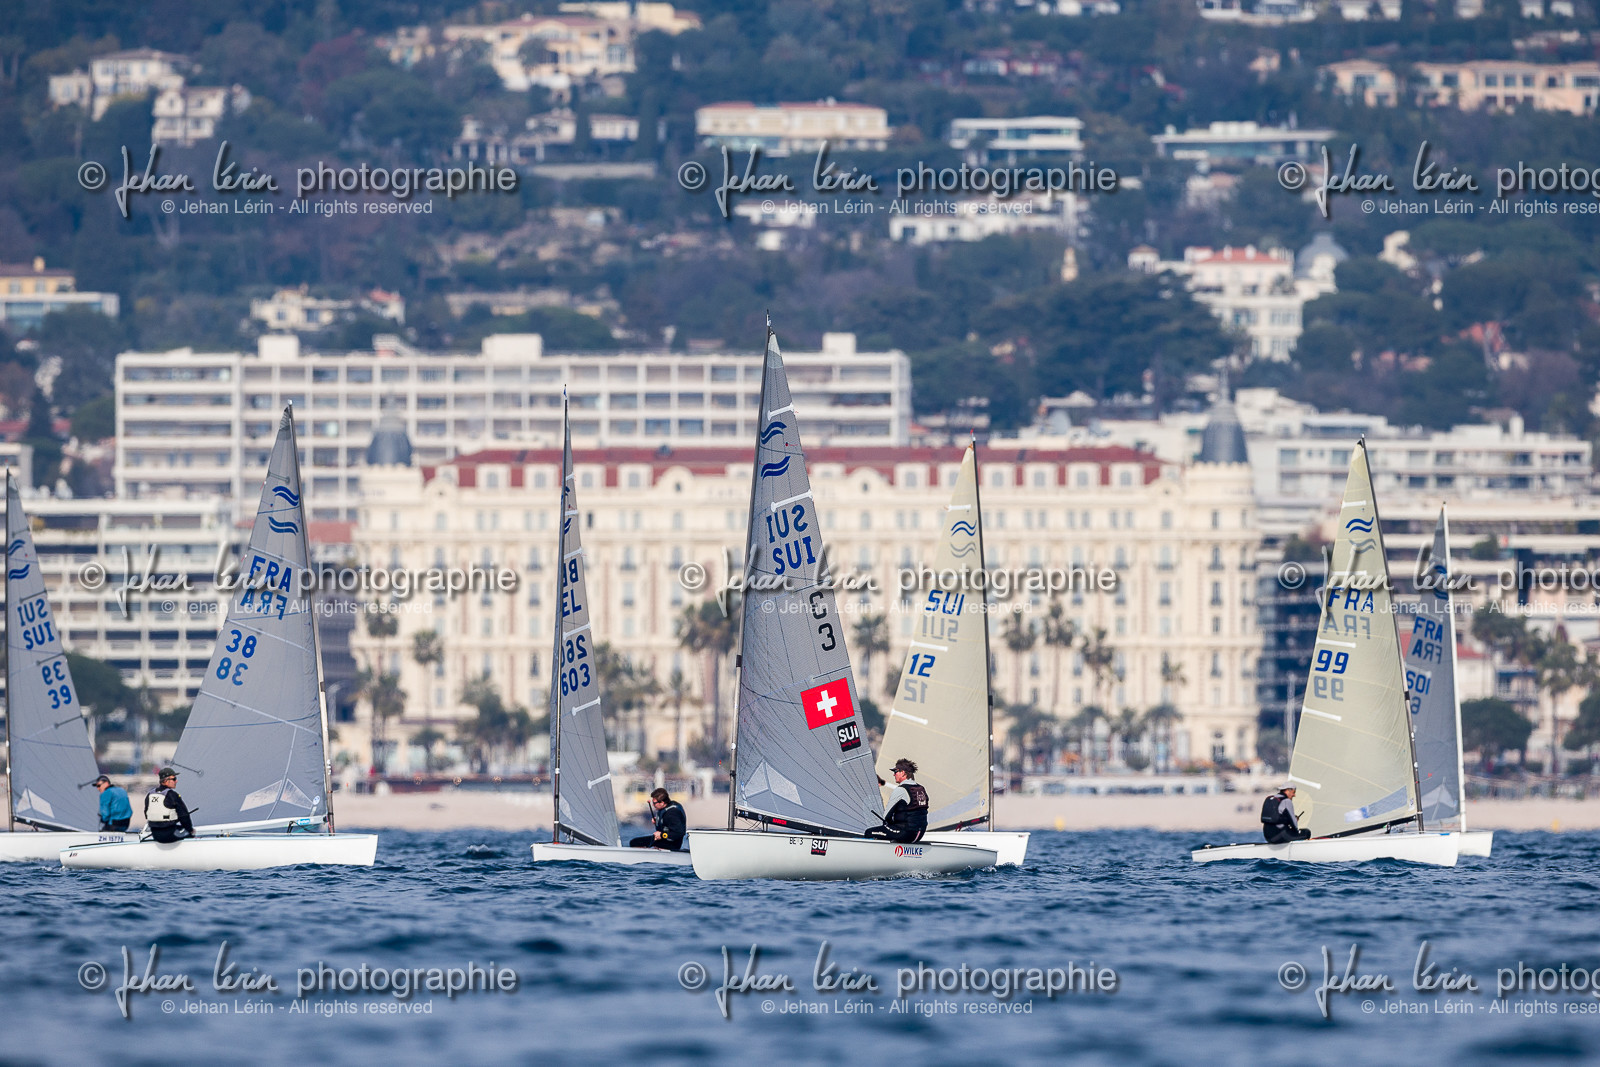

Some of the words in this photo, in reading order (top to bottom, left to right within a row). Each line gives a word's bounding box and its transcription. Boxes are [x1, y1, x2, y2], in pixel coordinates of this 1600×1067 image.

[772, 536, 816, 575] SUI
[249, 555, 292, 593] FRA
[925, 589, 965, 616] SUI
[1327, 586, 1374, 613] FRA
[23, 621, 55, 650] SUI
[818, 623, 836, 651] 3
[1413, 616, 1443, 643] FRA
[226, 629, 257, 658] 38
[909, 653, 936, 677] 12
[1315, 649, 1349, 674] 99
[561, 663, 590, 696] 603
[48, 685, 72, 709] 39
[904, 847, 923, 856] WILKE
